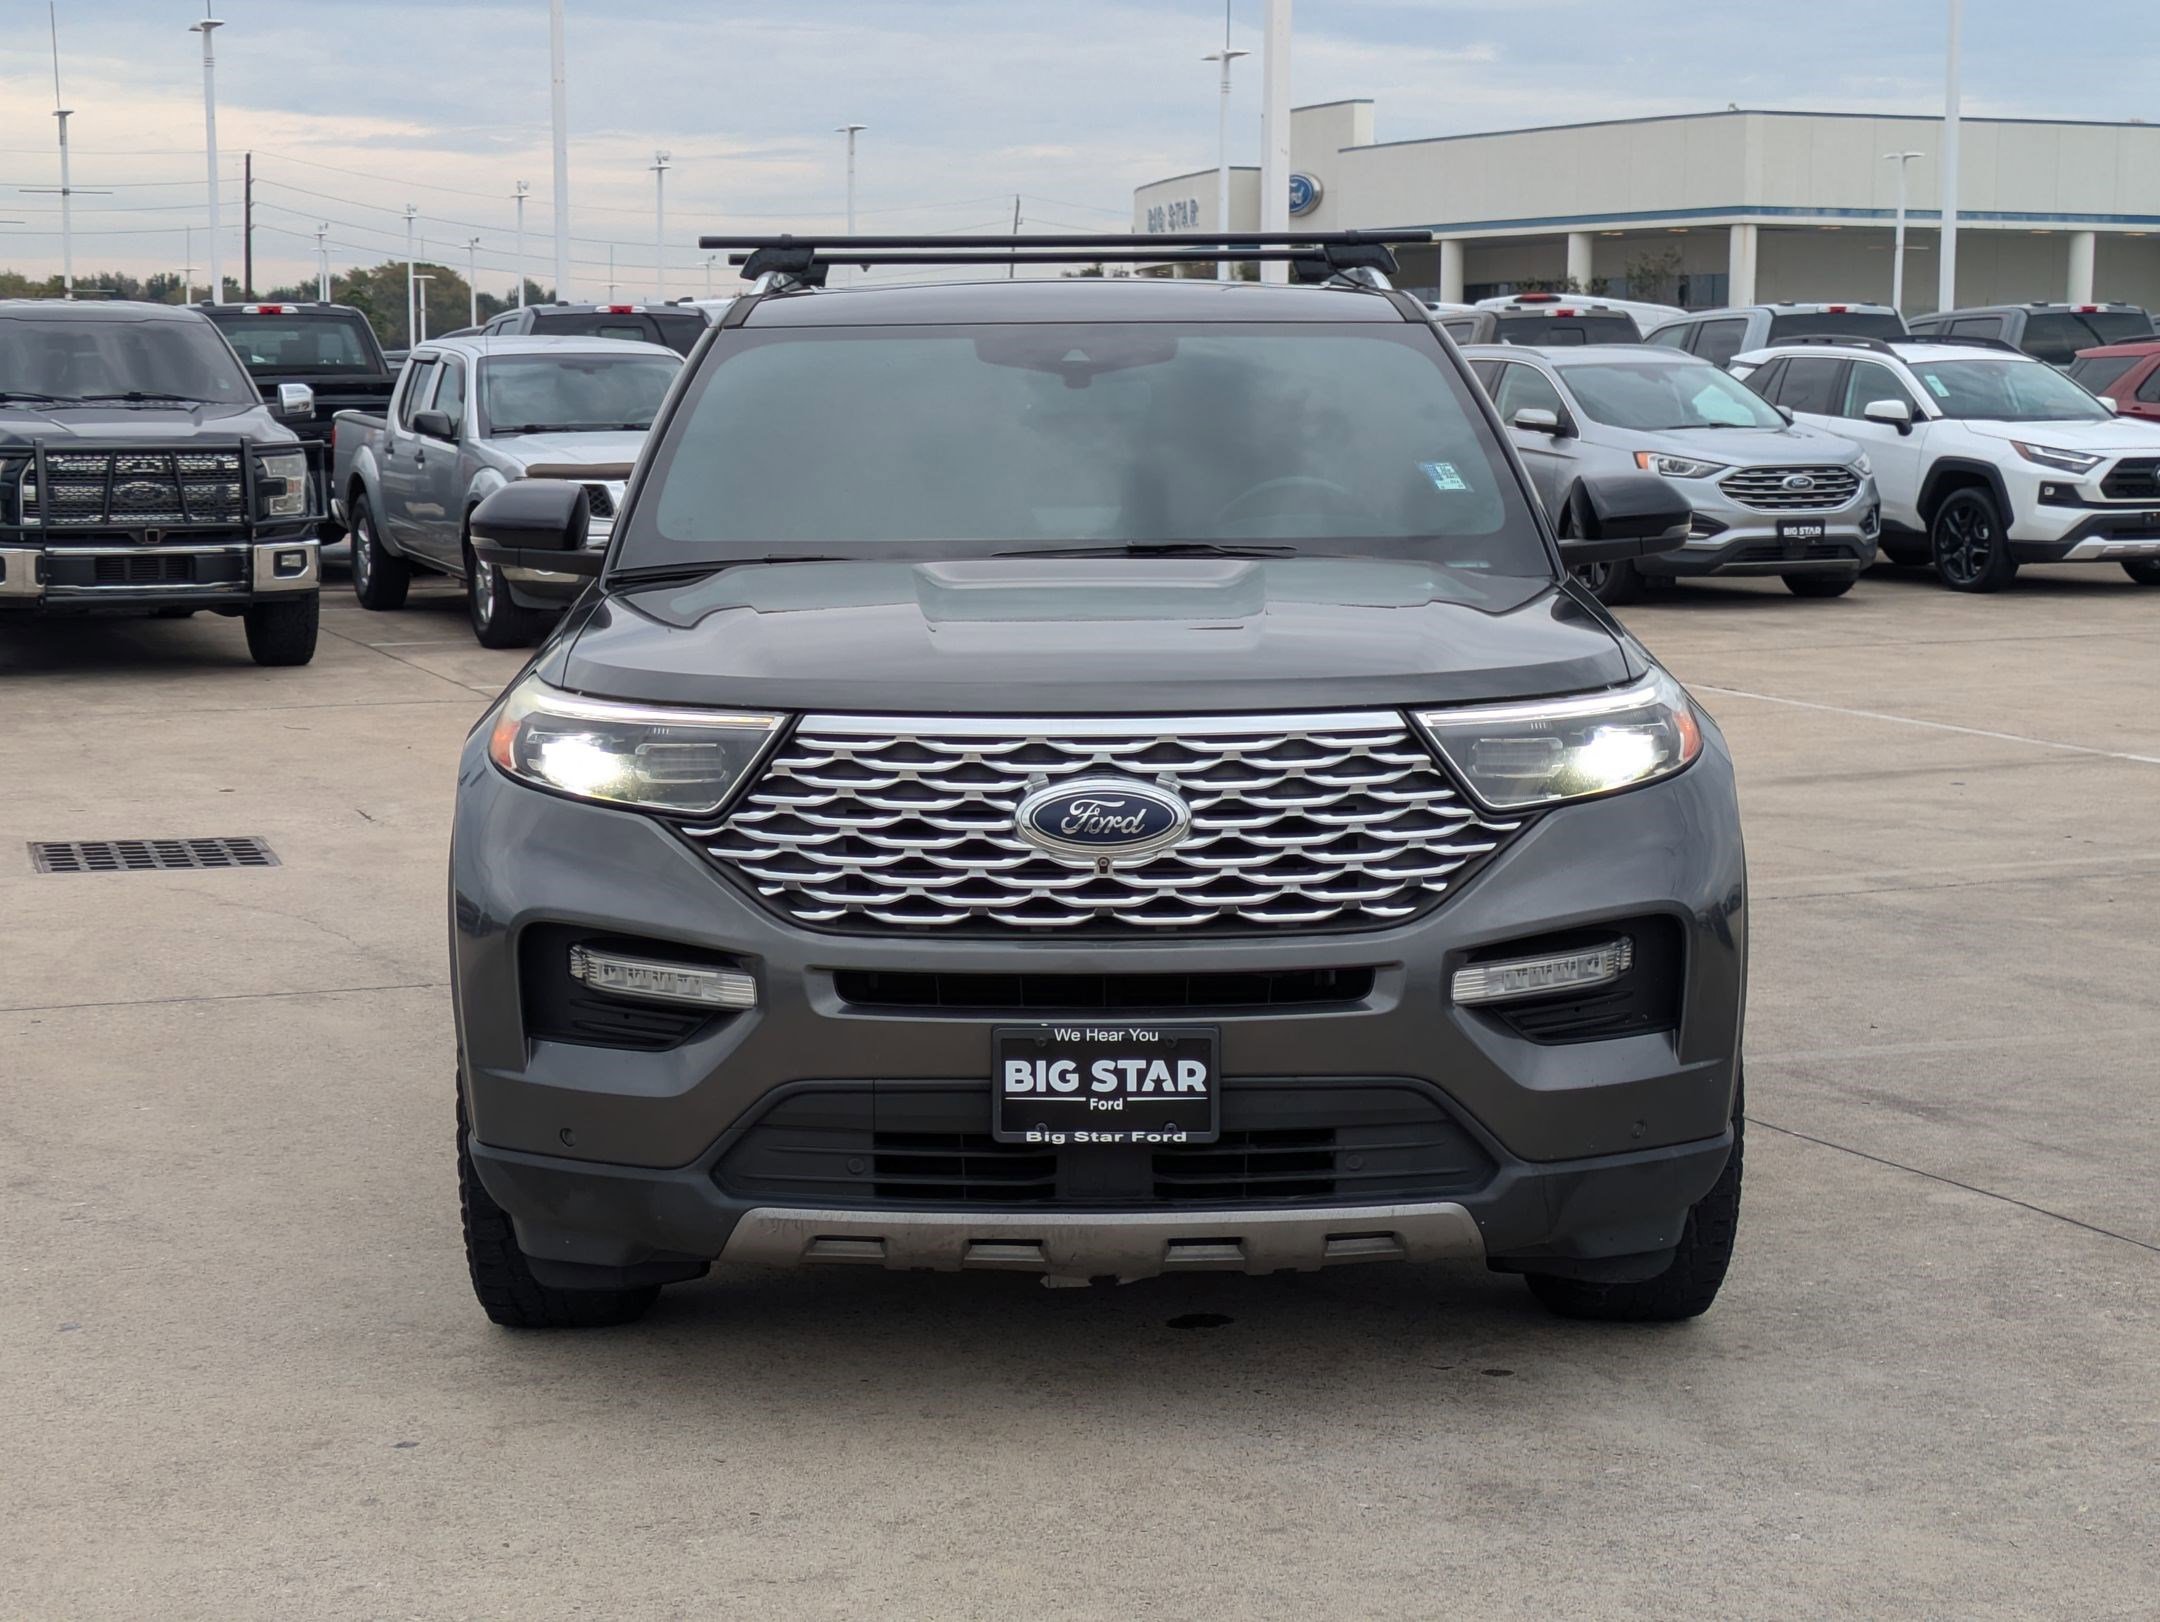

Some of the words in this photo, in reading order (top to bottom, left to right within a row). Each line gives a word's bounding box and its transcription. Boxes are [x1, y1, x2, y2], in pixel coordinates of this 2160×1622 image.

[1168, 199, 1199, 231] STAR
[1783, 526, 1798, 536] BIG
[1799, 526, 1822, 535] STAR
[1061, 799, 1147, 834] Ford
[1054, 1028, 1081, 1042] We
[1086, 1028, 1125, 1042] Hear
[1129, 1028, 1159, 1042] You
[1005, 1060, 1079, 1092] BIG
[1091, 1060, 1207, 1092] STAR
[1090, 1098, 1123, 1110] Ford
[1026, 1131, 1065, 1144] Big
[1074, 1131, 1124, 1143] Star
[1131, 1131, 1187, 1143] Ford
